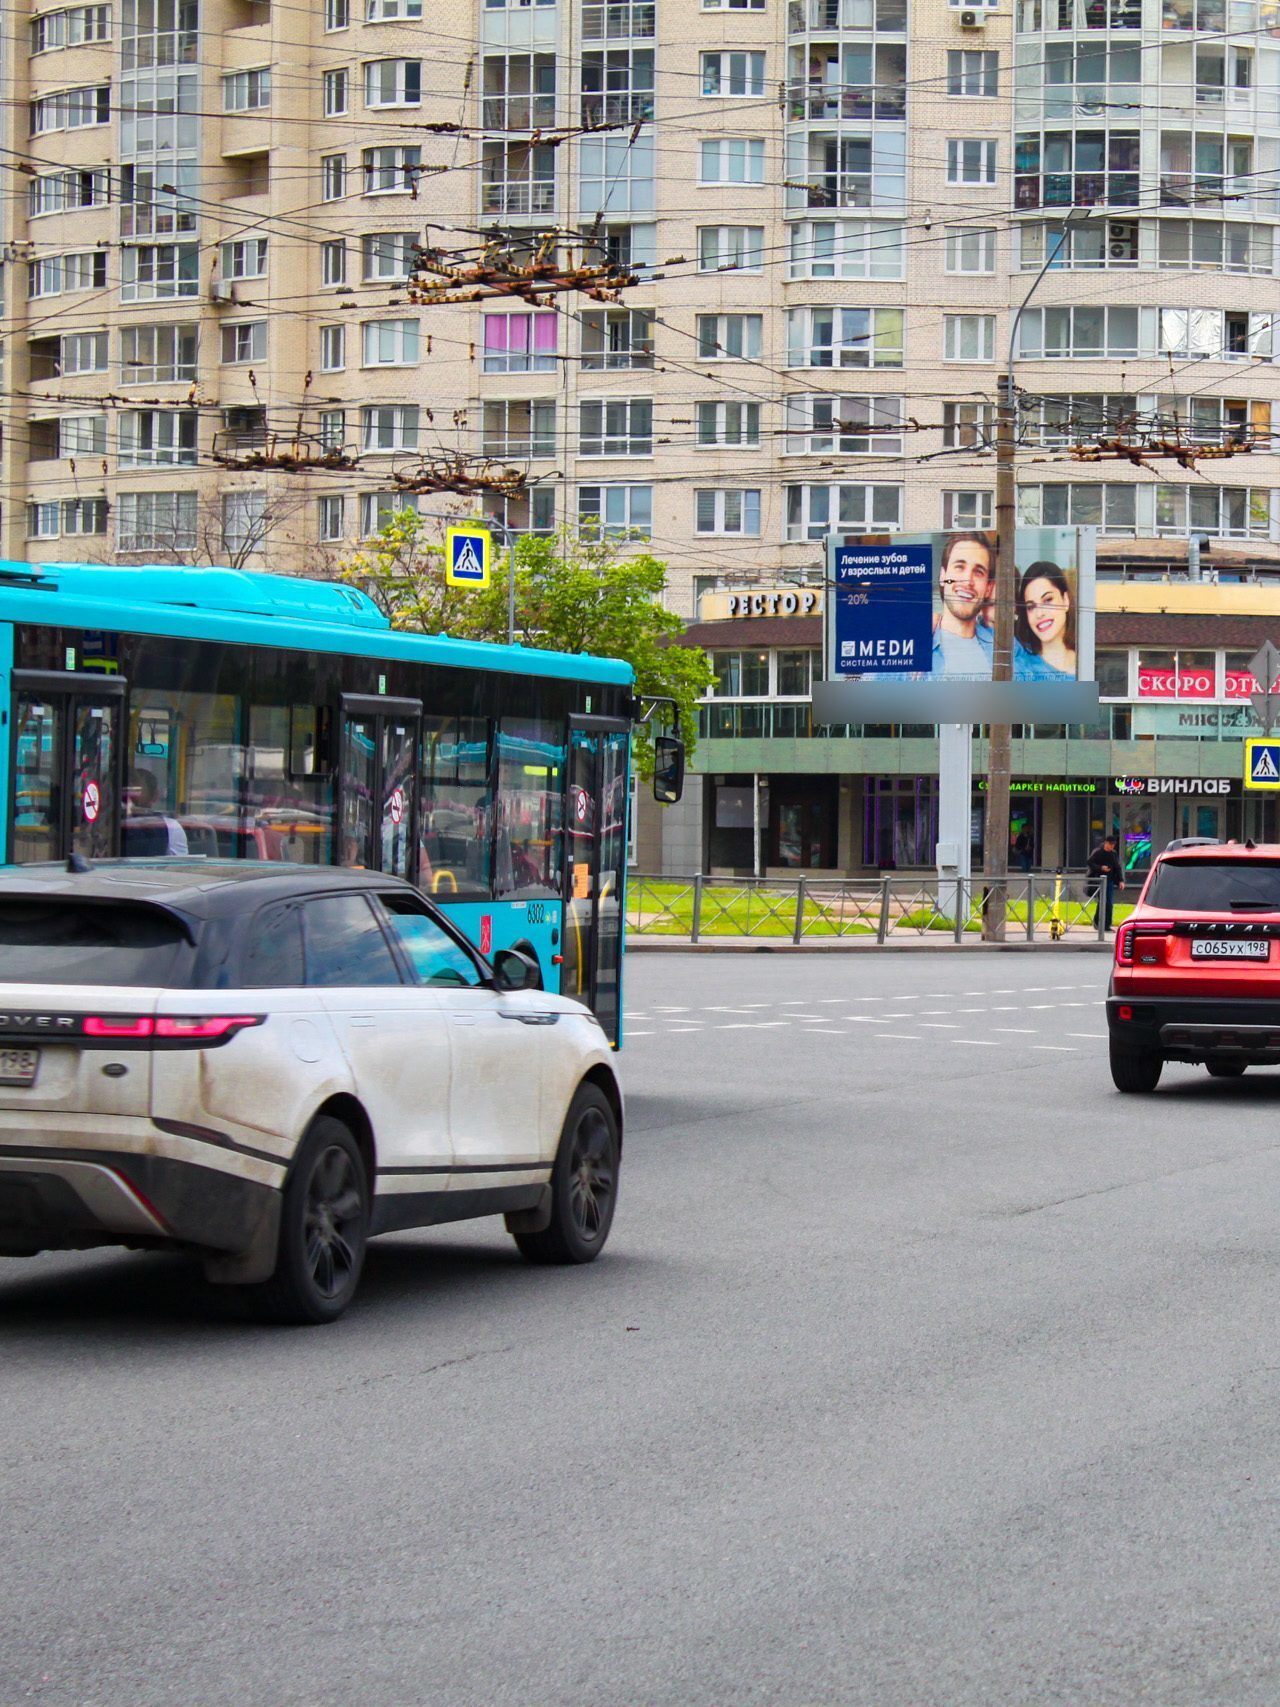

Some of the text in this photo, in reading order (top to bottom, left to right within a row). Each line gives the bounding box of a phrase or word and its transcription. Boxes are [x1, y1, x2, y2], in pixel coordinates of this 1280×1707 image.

[841, 553, 908, 565] Лечение зубов
[841, 564, 926, 578] у взрослых и детей
[1138, 675, 1210, 691] СКОРО
[1046, 783, 1096, 792] НАПИТКОВ
[527, 903, 544, 924] 6302
[1188, 923, 1270, 932] HAVAL
